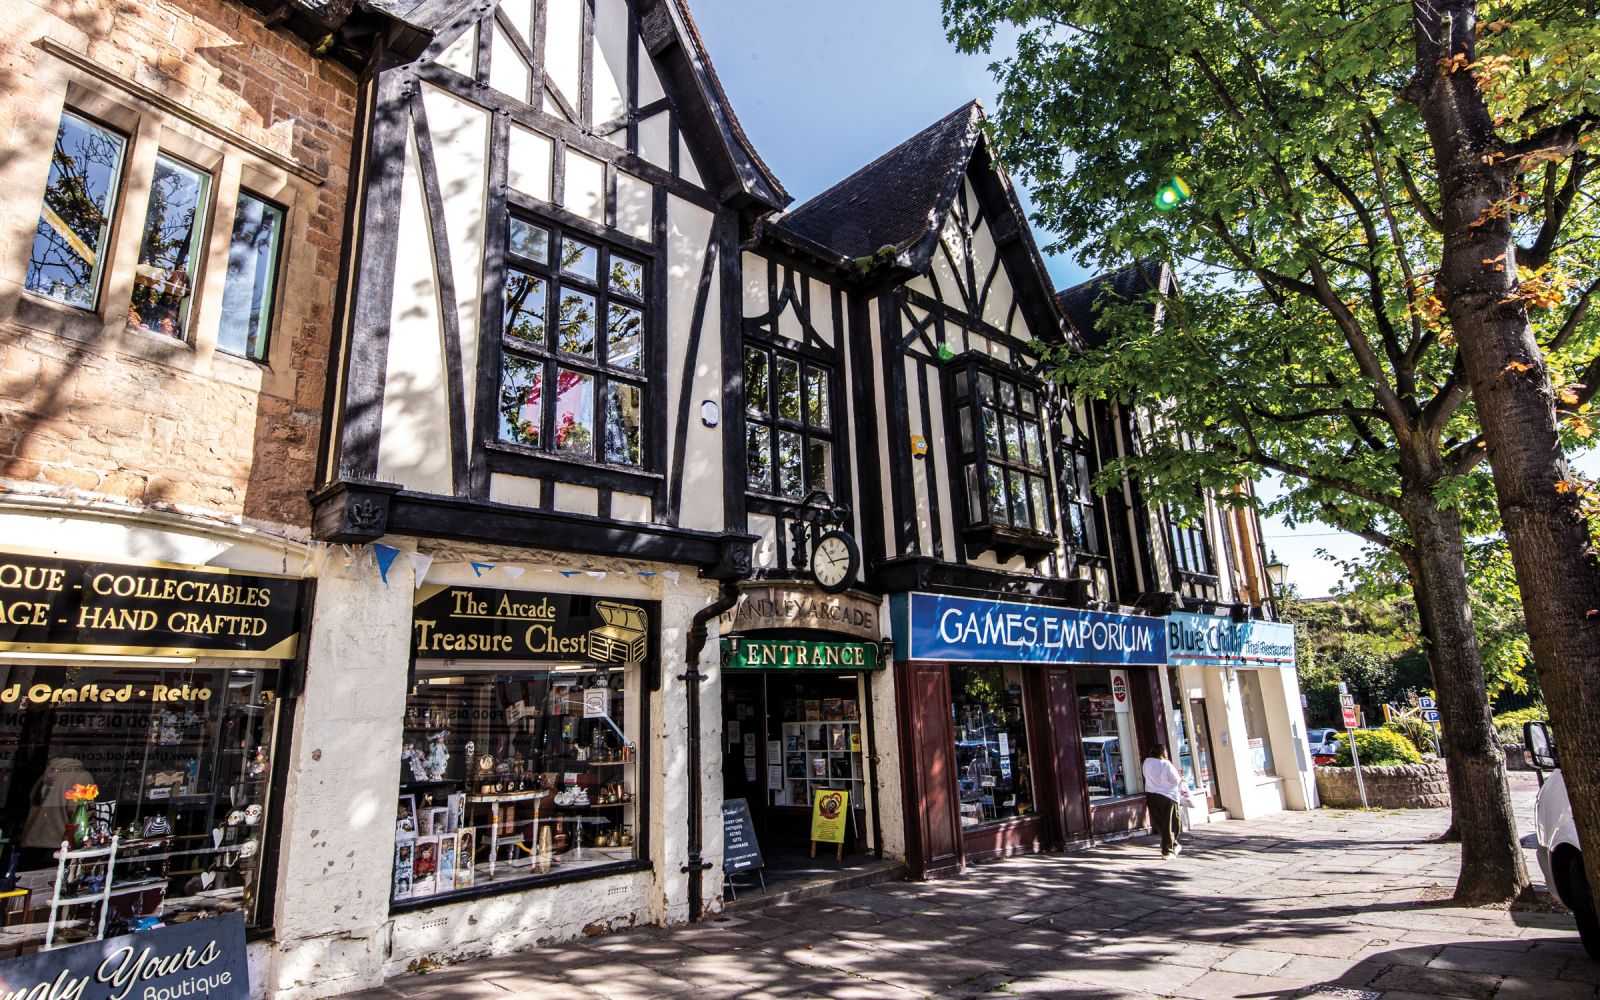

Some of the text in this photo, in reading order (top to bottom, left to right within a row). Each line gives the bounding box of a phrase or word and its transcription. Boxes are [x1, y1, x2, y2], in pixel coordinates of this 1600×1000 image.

[92, 574, 271, 607] COLLECTABLES
[451, 590, 556, 618] The Arcade
[76, 606, 158, 630] HAND
[168, 611, 268, 637] CRAFTED
[809, 600, 873, 628] ARCADE
[414, 620, 587, 653] Treasure Chest
[940, 608, 1153, 652] GAMES EMPORIUM
[1169, 621, 1204, 651] Blue
[747, 644, 865, 666] ENTRANCE
[28, 683, 134, 703] Crafted
[153, 684, 211, 702] Retro
[97, 940, 221, 1000] Yours
[144, 971, 232, 1000] Boutique
